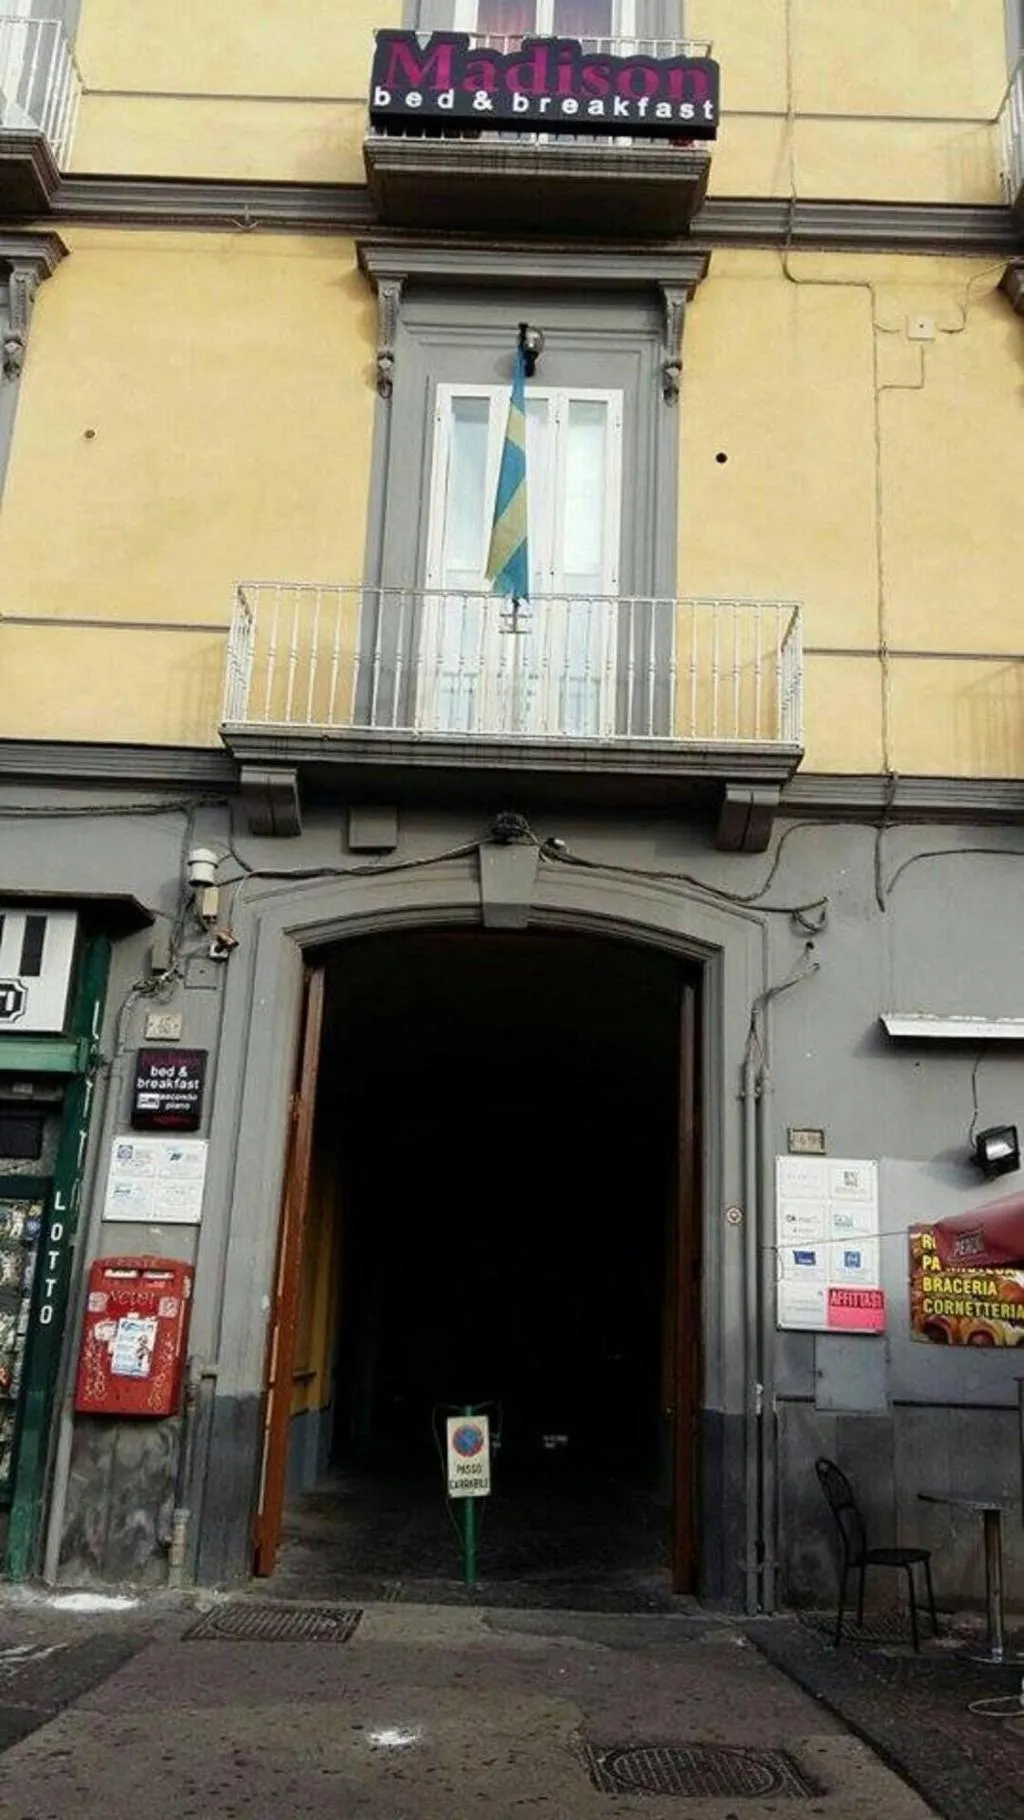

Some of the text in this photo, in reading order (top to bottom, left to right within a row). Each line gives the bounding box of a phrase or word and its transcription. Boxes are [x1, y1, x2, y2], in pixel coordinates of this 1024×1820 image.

[381, 38, 710, 99] Madison
[374, 87, 714, 120] bed & breakfast
[150, 1065, 175, 1077] bed
[136, 1077, 200, 1090] breakfast
[39, 1191, 66, 1324] LOTTO
[922, 1276, 998, 1296] BRACERIA
[922, 1298, 1024, 1319] CORNETTERIA
